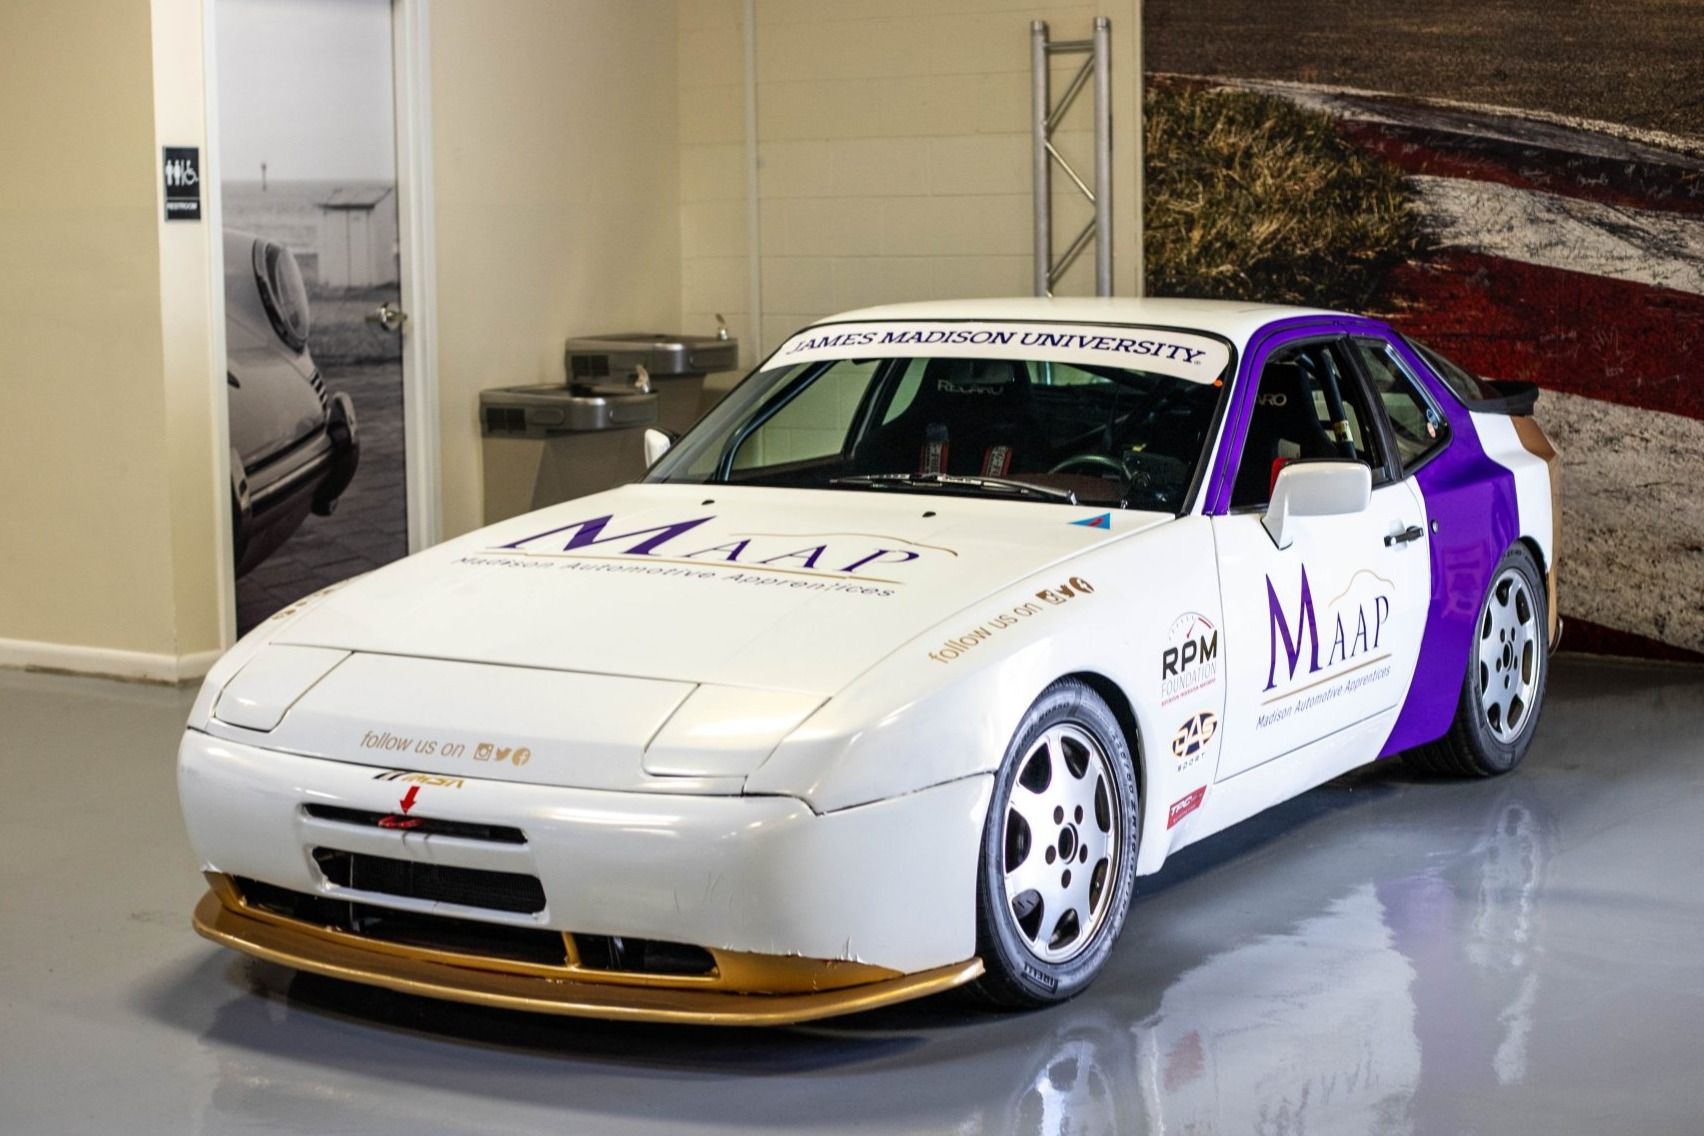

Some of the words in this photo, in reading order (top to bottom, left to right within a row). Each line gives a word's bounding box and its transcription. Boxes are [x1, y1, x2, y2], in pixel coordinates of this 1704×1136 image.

[786, 331, 878, 355] JAMES
[878, 331, 1018, 345] MADISON
[1020, 332, 1206, 364] UNIVERSITY
[485, 514, 920, 573] MAAP
[560, 562, 716, 579] Automotive
[722, 573, 896, 597] Apprentices
[928, 626, 993, 665] follow
[988, 614, 1019, 630] us
[1013, 602, 1044, 617] on
[1262, 562, 1389, 693] MAAP
[1161, 660, 1217, 698] FOUNDATION
[1162, 629, 1218, 681] RPM
[1256, 704, 1293, 731] Madison
[1294, 684, 1343, 713] Automotive
[1344, 664, 1391, 696] Apprentices
[360, 730, 413, 751] follow
[414, 740, 438, 755] us
[440, 742, 466, 758] on
